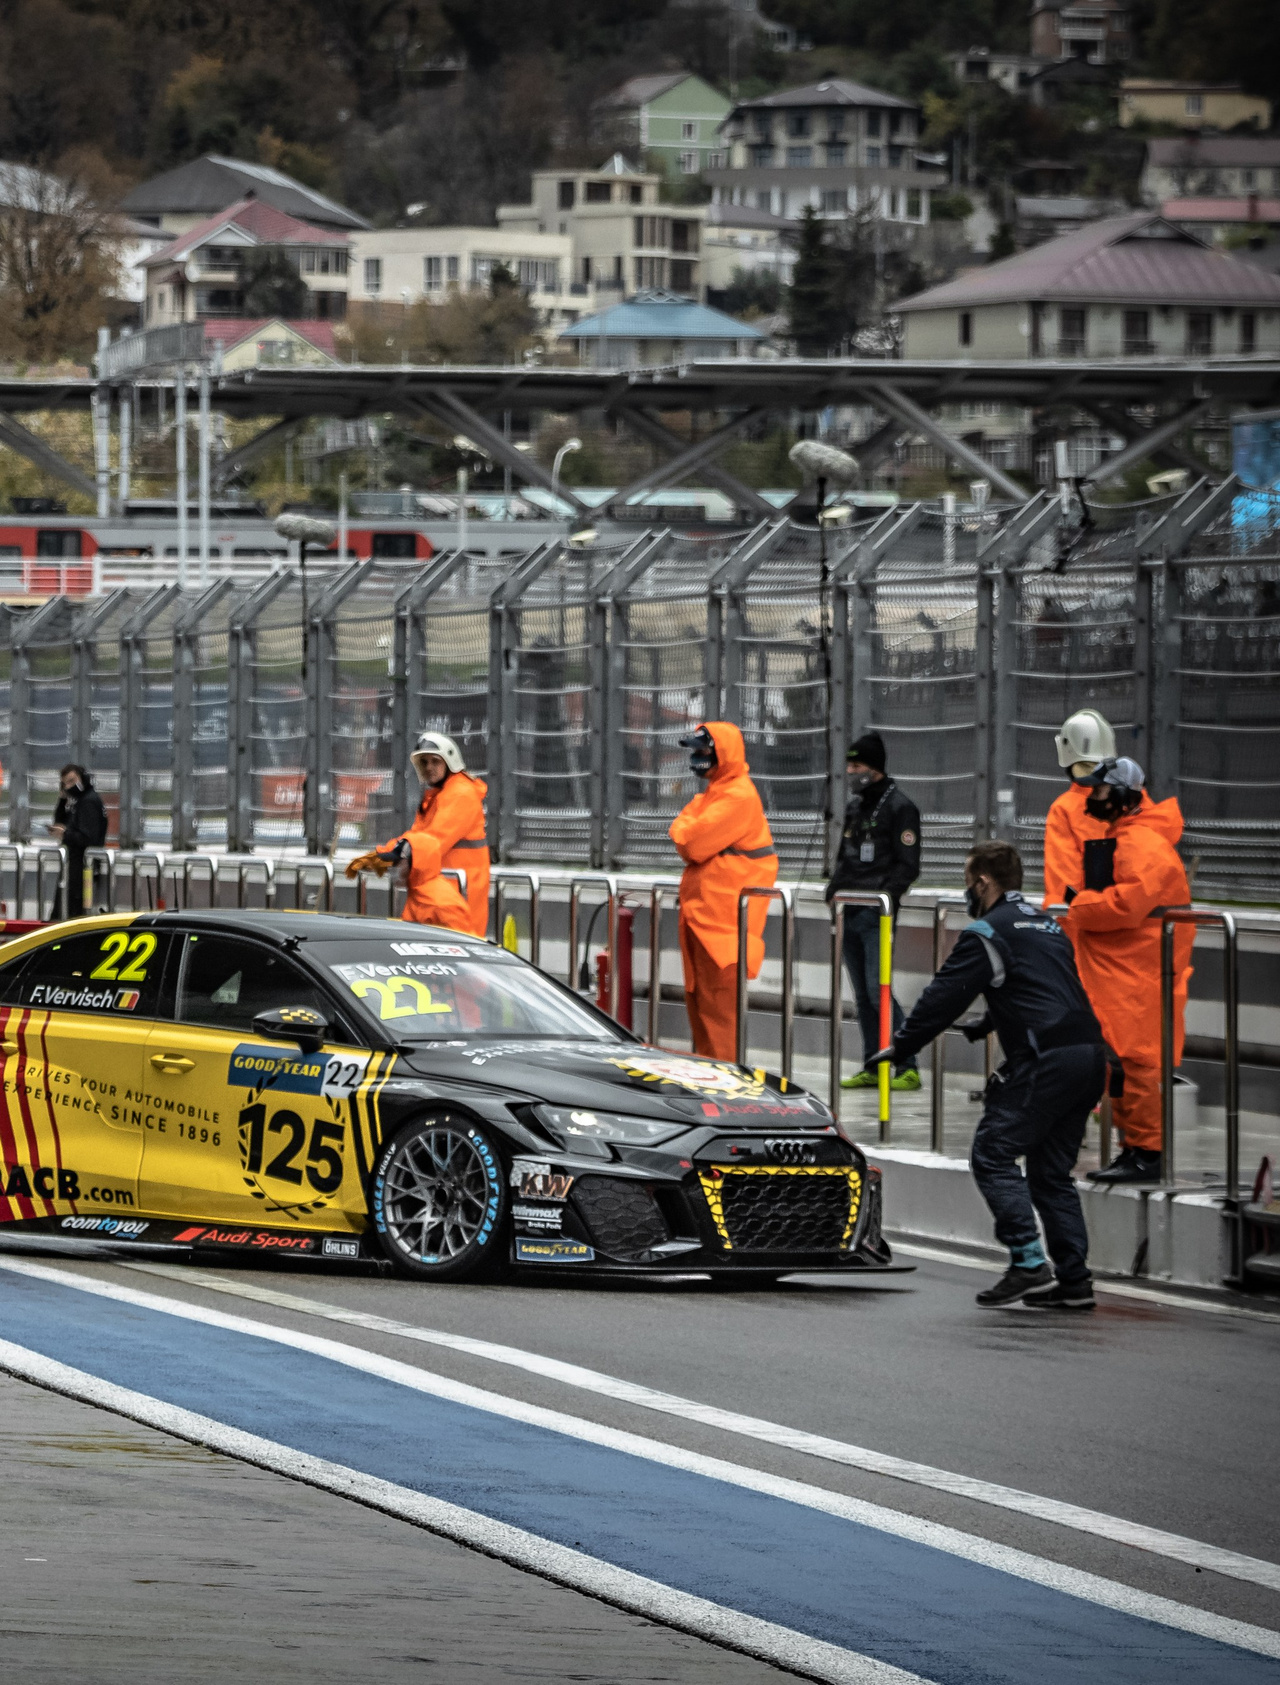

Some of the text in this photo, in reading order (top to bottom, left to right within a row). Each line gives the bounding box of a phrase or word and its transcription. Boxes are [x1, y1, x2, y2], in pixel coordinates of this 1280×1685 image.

[89, 931, 158, 982] 22
[339, 961, 458, 981] F.Vervisch
[29, 984, 115, 1009] F.Vervisch
[350, 976, 453, 1021] 22
[234, 1056, 360, 1089] GOODYEAR 22
[16, 1064, 221, 1124] DRIVES YOUR AUTOMOBILE
[723, 1103, 764, 1115] Audi
[2, 1080, 222, 1147] EXPERIENCE SINCE 1896
[238, 1103, 346, 1195] 125
[471, 1135, 501, 1246] GOODYEAR
[518, 1173, 575, 1199] KW
[374, 1176, 388, 1234] EAGLE
[61, 1216, 151, 1235] comtoyou
[201, 1228, 313, 1249] Audi Sport
[521, 1243, 588, 1256] GOODYEAR
